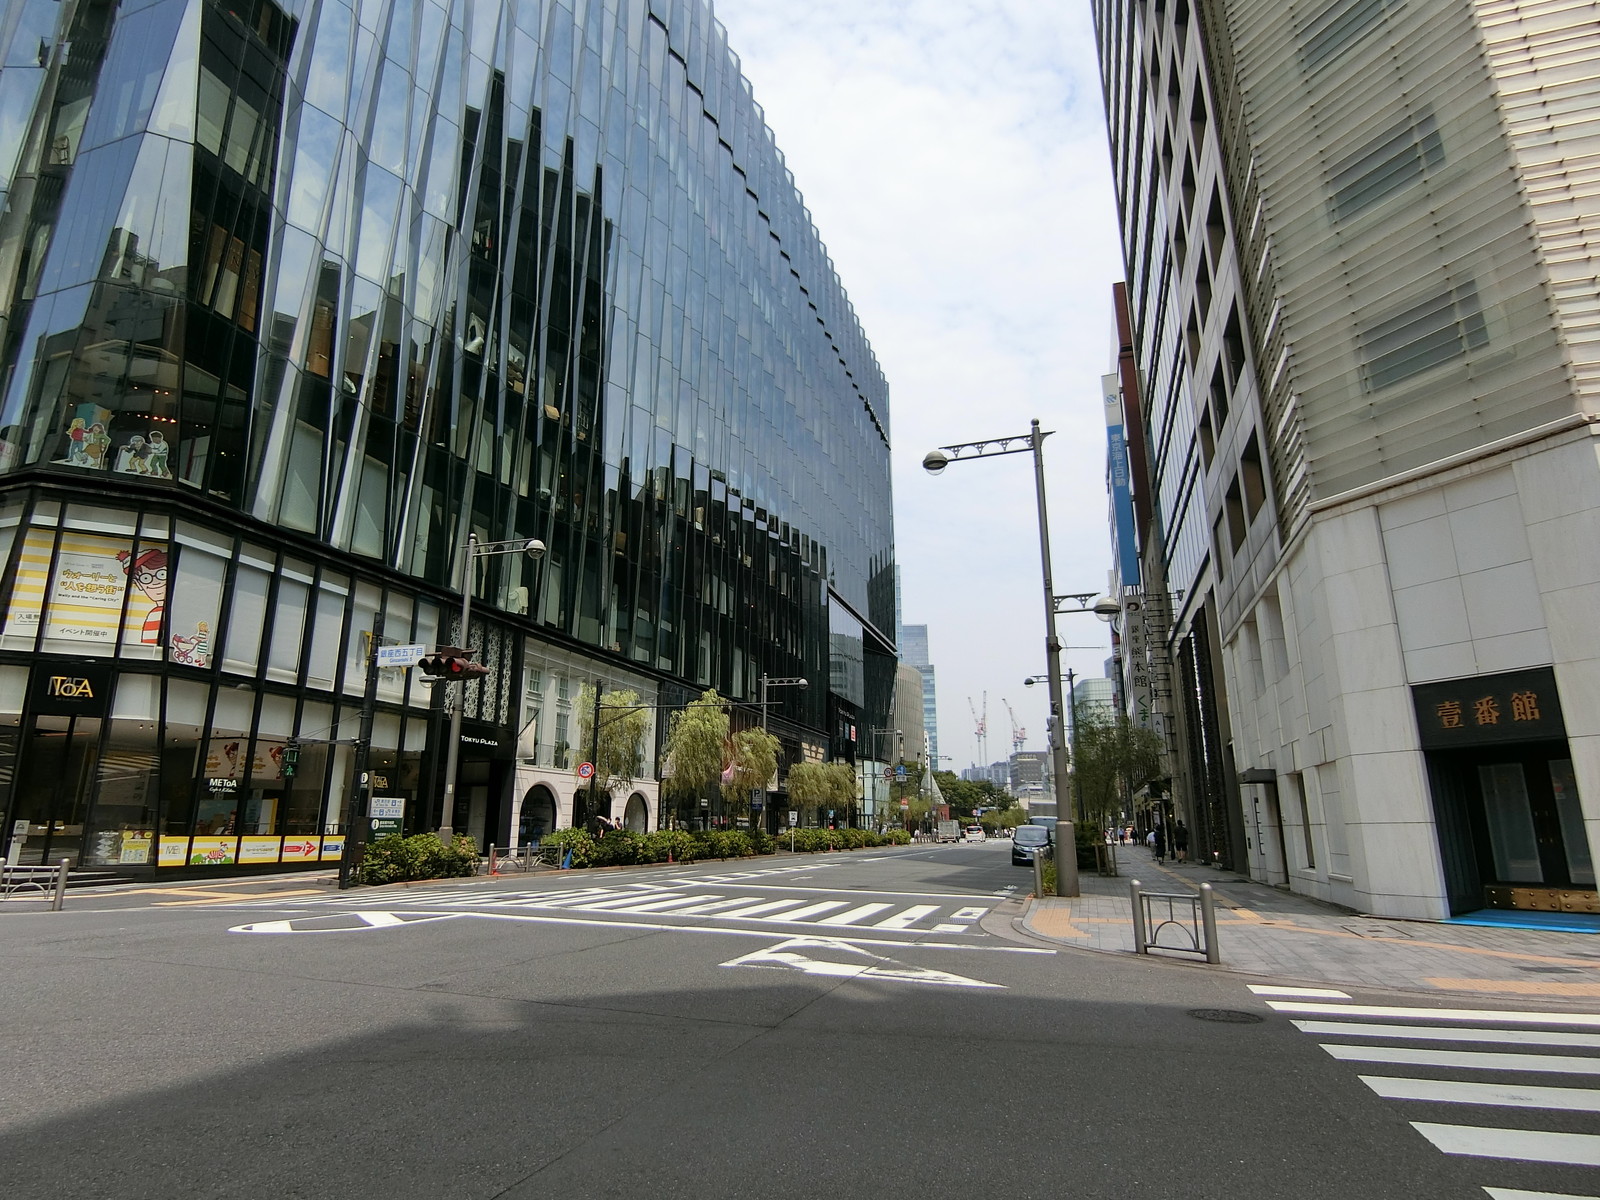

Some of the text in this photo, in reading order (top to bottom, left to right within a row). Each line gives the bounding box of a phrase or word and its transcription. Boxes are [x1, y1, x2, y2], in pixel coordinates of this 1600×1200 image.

[60, 627, 107, 637] イベント開催中
[380, 647, 423, 658] 銀座西五丁目
[461, 735, 498, 746] TOKYU PLAZA
